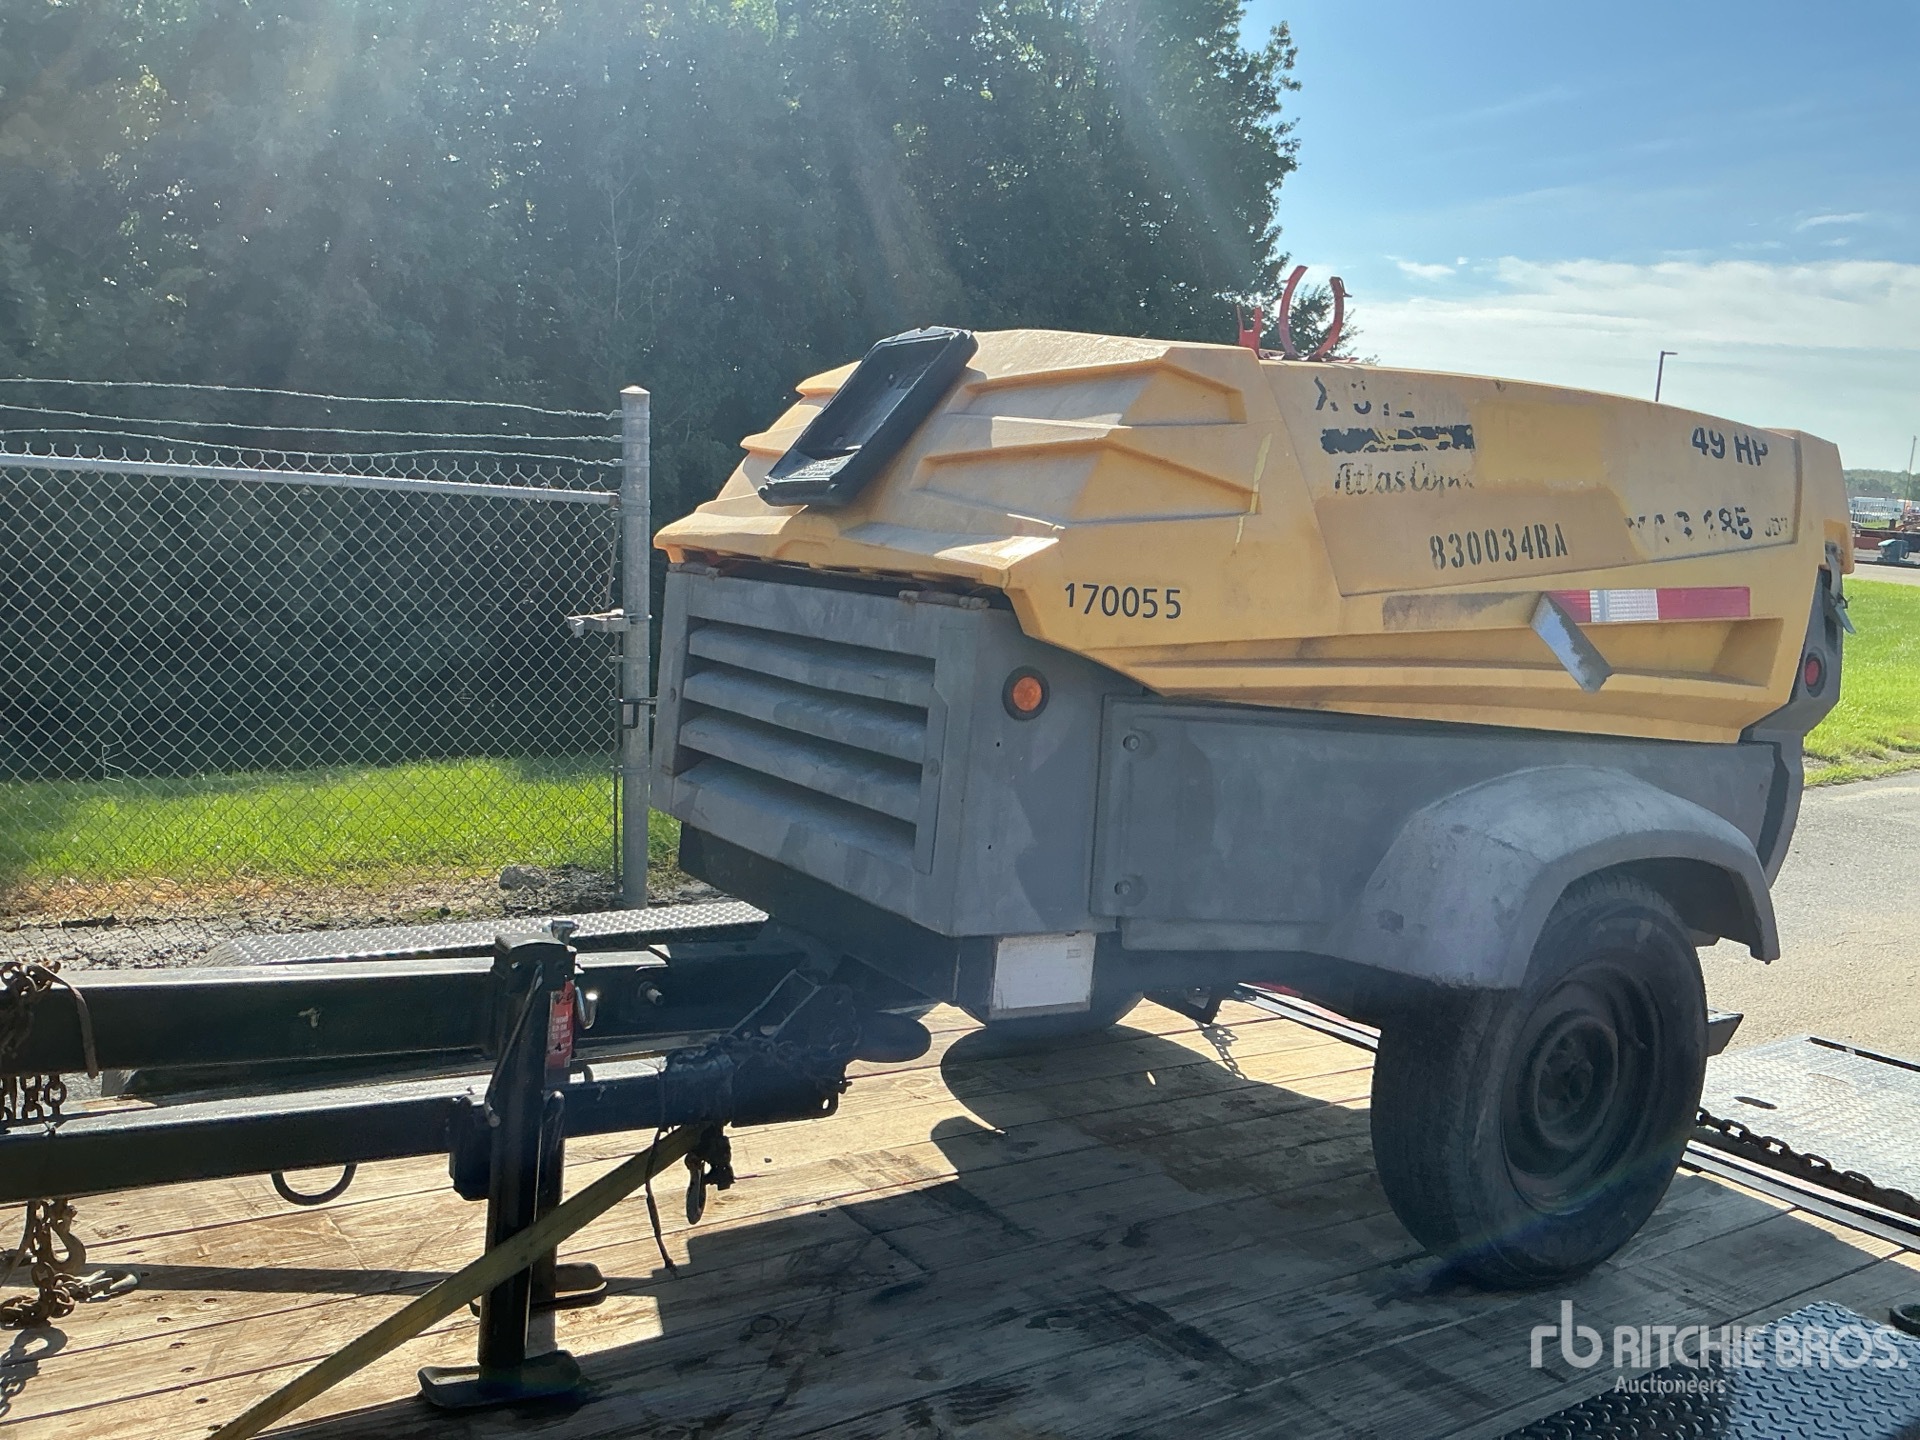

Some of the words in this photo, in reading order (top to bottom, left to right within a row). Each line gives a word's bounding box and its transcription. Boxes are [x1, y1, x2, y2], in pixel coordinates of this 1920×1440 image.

[1691, 427, 1725, 459] 49
[1733, 431, 1769, 466] HP
[1429, 523, 1568, 570] 830034RA
[1065, 583, 1181, 619] 170055
